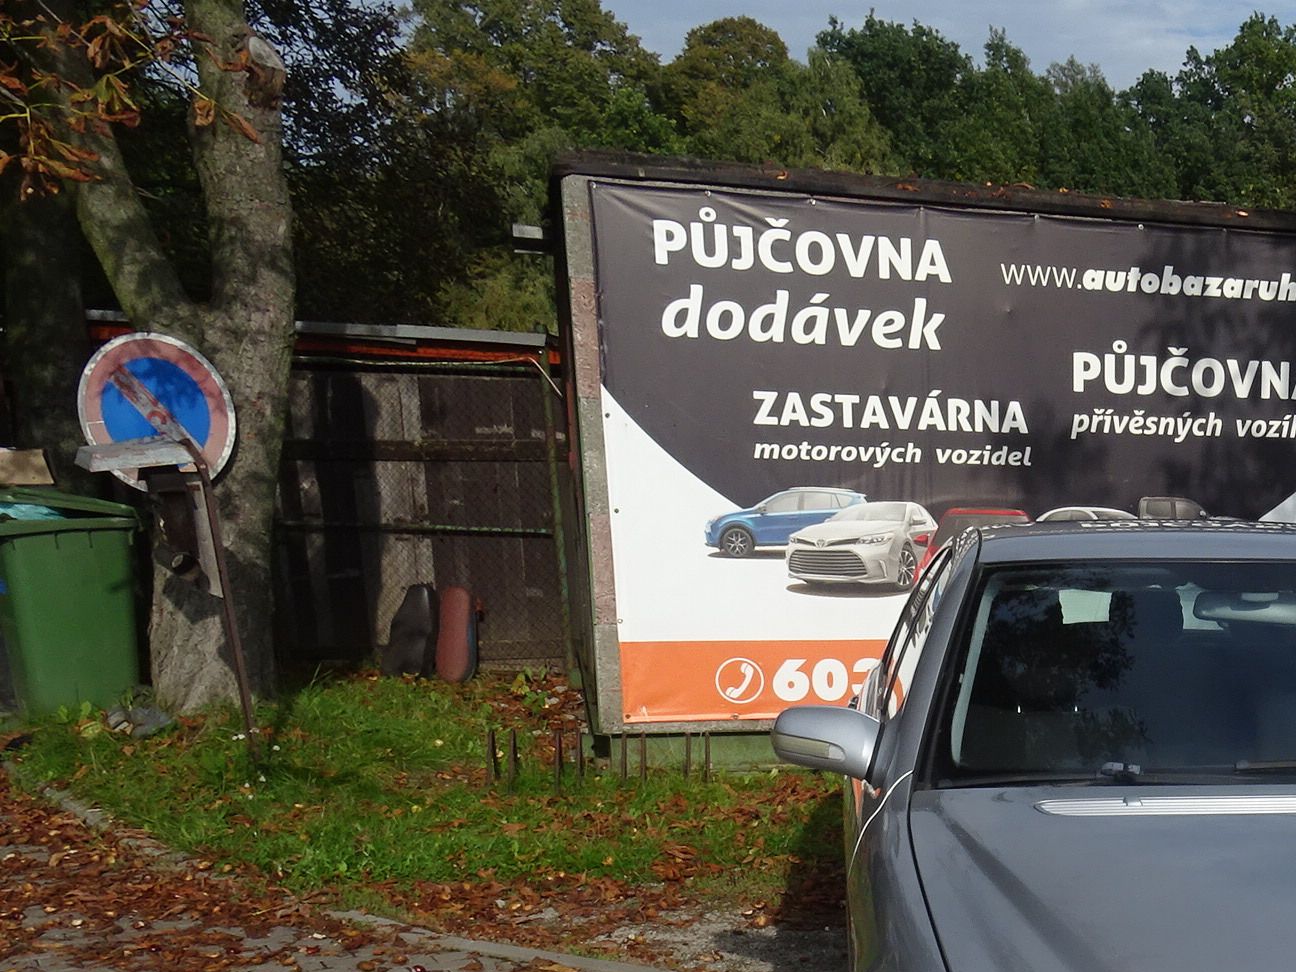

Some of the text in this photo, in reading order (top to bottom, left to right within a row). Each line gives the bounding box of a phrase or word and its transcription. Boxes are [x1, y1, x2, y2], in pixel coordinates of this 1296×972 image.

[652, 206, 953, 284] PŮJČOVNA
[660, 283, 946, 350] dodávek
[752, 389, 1029, 434] ZASTAVÁRNA
[1070, 408, 1222, 443] přívěsných
[753, 442, 1032, 468] motorových vozidel
